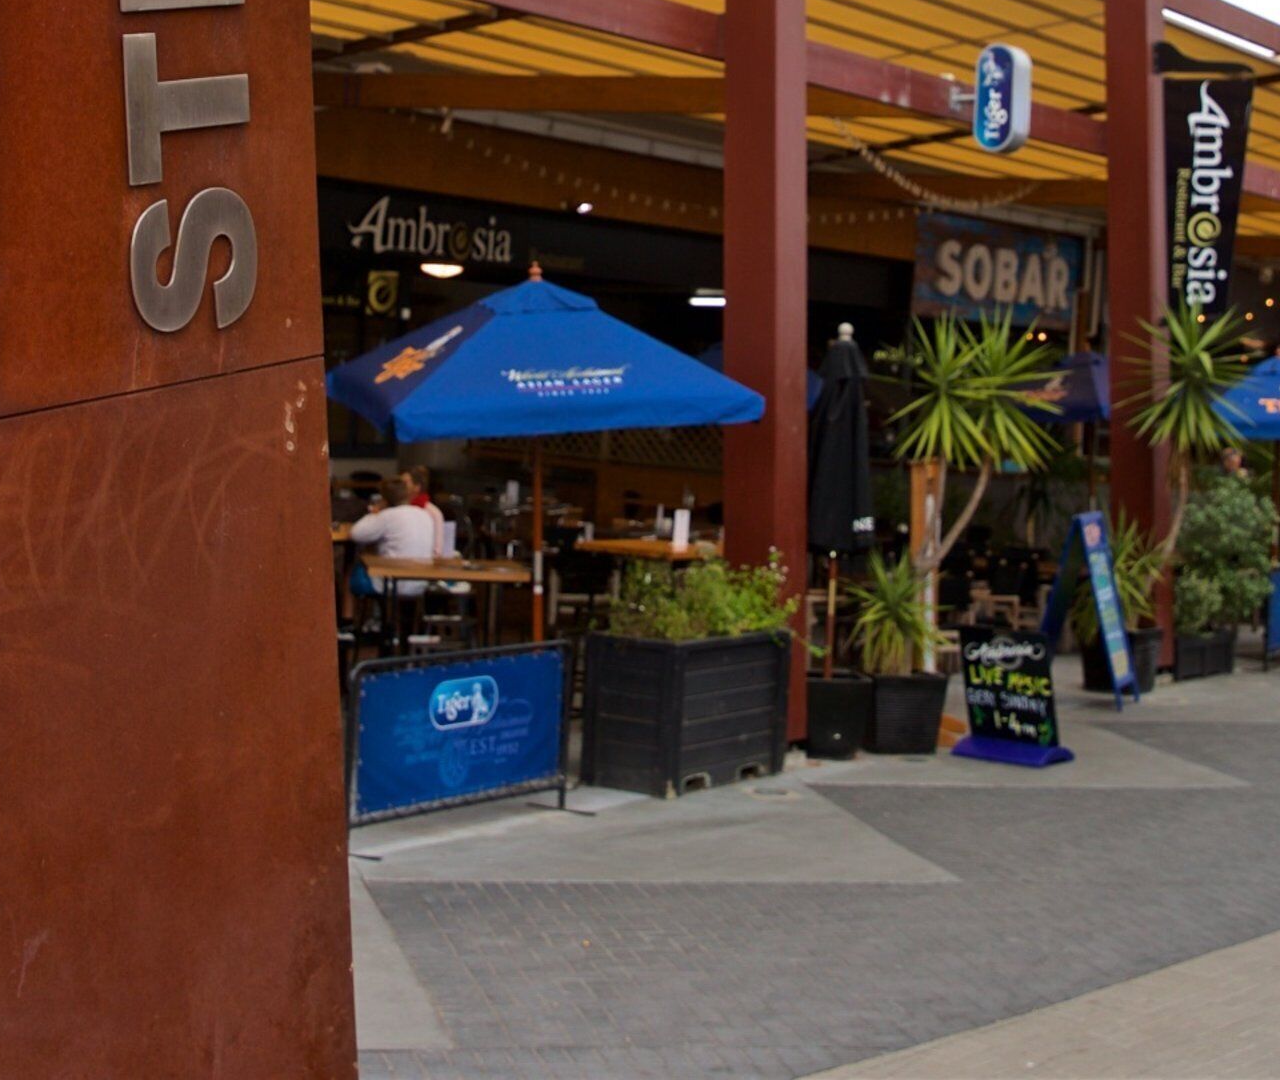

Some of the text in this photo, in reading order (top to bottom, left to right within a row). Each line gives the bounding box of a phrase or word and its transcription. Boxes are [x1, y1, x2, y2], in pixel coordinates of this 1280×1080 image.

[1187, 80, 1234, 306] Ambrosia
[347, 195, 513, 263] Ambrosia
[937, 239, 1071, 309] SOBAR
[968, 664, 1004, 686] LIVE
